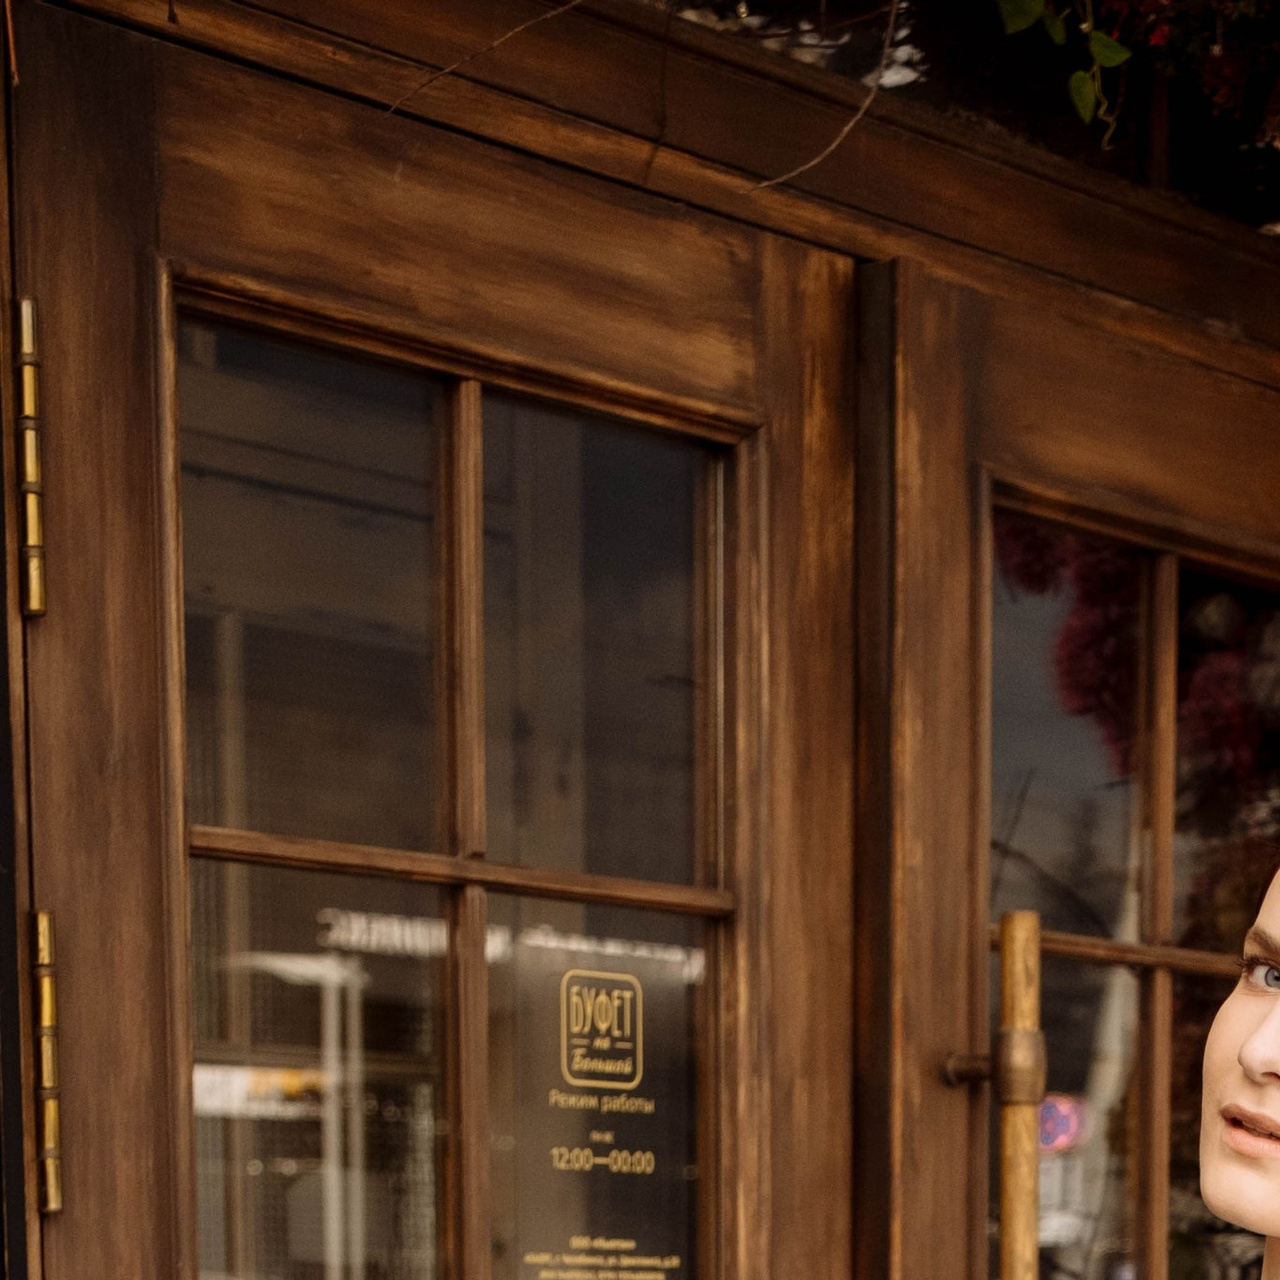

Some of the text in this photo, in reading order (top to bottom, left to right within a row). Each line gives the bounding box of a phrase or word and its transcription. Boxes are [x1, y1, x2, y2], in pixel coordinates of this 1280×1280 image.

[570, 985, 633, 1038] БУФЕТ
[548, 1088, 655, 1114] Режим работы
